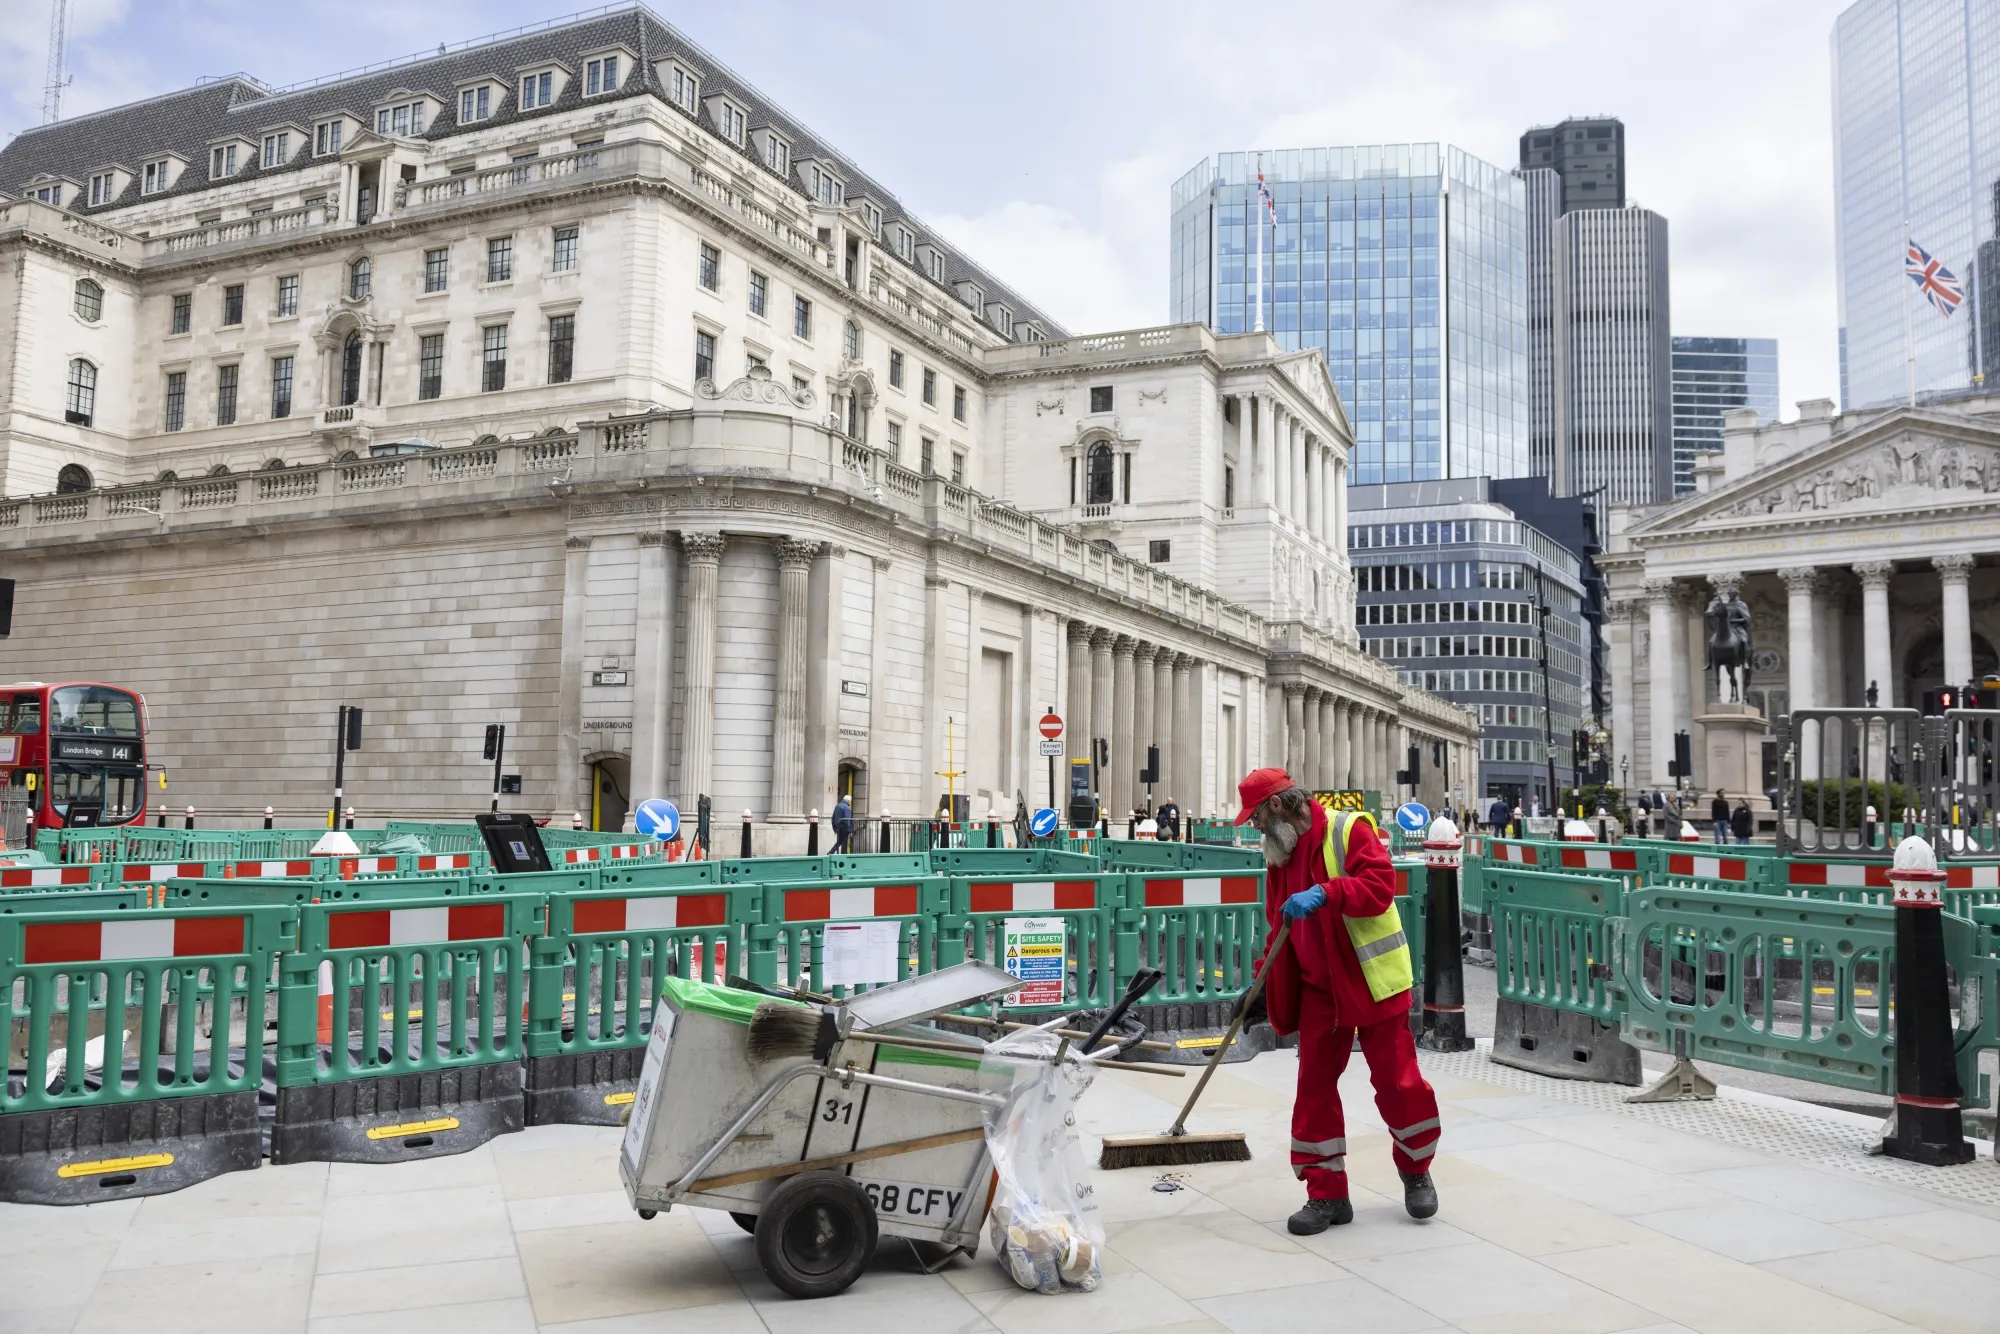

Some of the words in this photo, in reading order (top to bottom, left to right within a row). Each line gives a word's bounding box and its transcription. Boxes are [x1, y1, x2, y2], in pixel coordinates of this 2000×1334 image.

[63, 746, 84, 754] London
[85, 747, 103, 756] Bridge
[112, 747, 128, 759] 141
[822, 1099, 853, 1125] 31
[906, 1187, 962, 1218] CFY
